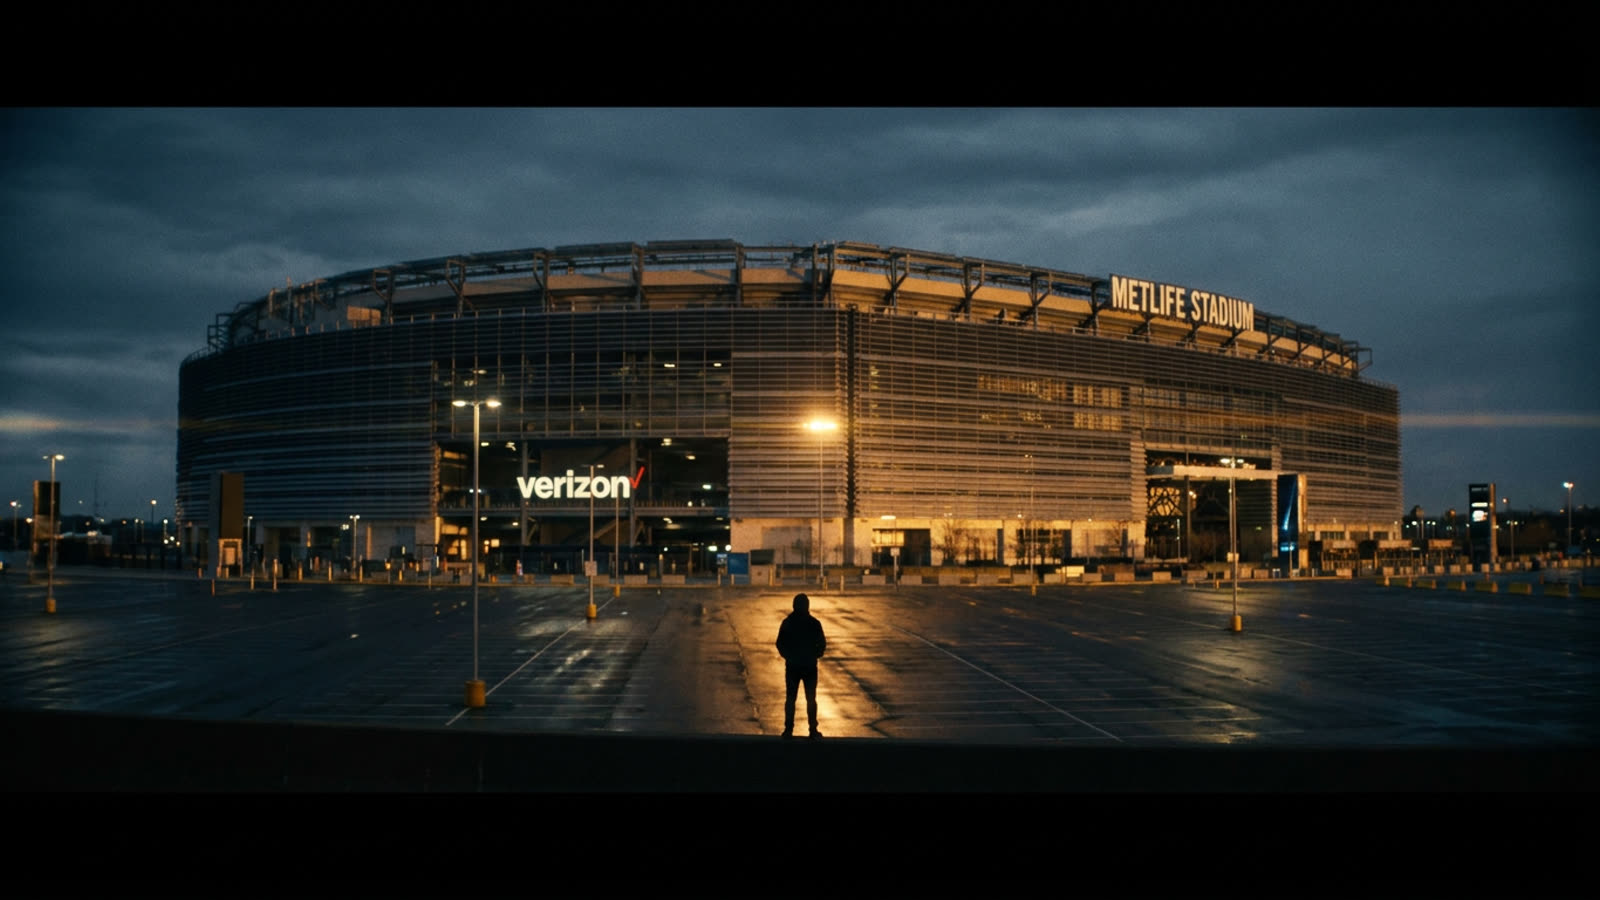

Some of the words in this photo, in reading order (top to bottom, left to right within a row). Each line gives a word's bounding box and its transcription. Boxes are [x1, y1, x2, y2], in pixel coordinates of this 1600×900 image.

[1111, 275, 1186, 319] METLIFE
[1190, 289, 1254, 332] STADIUM
[516, 469, 630, 499] verizon
